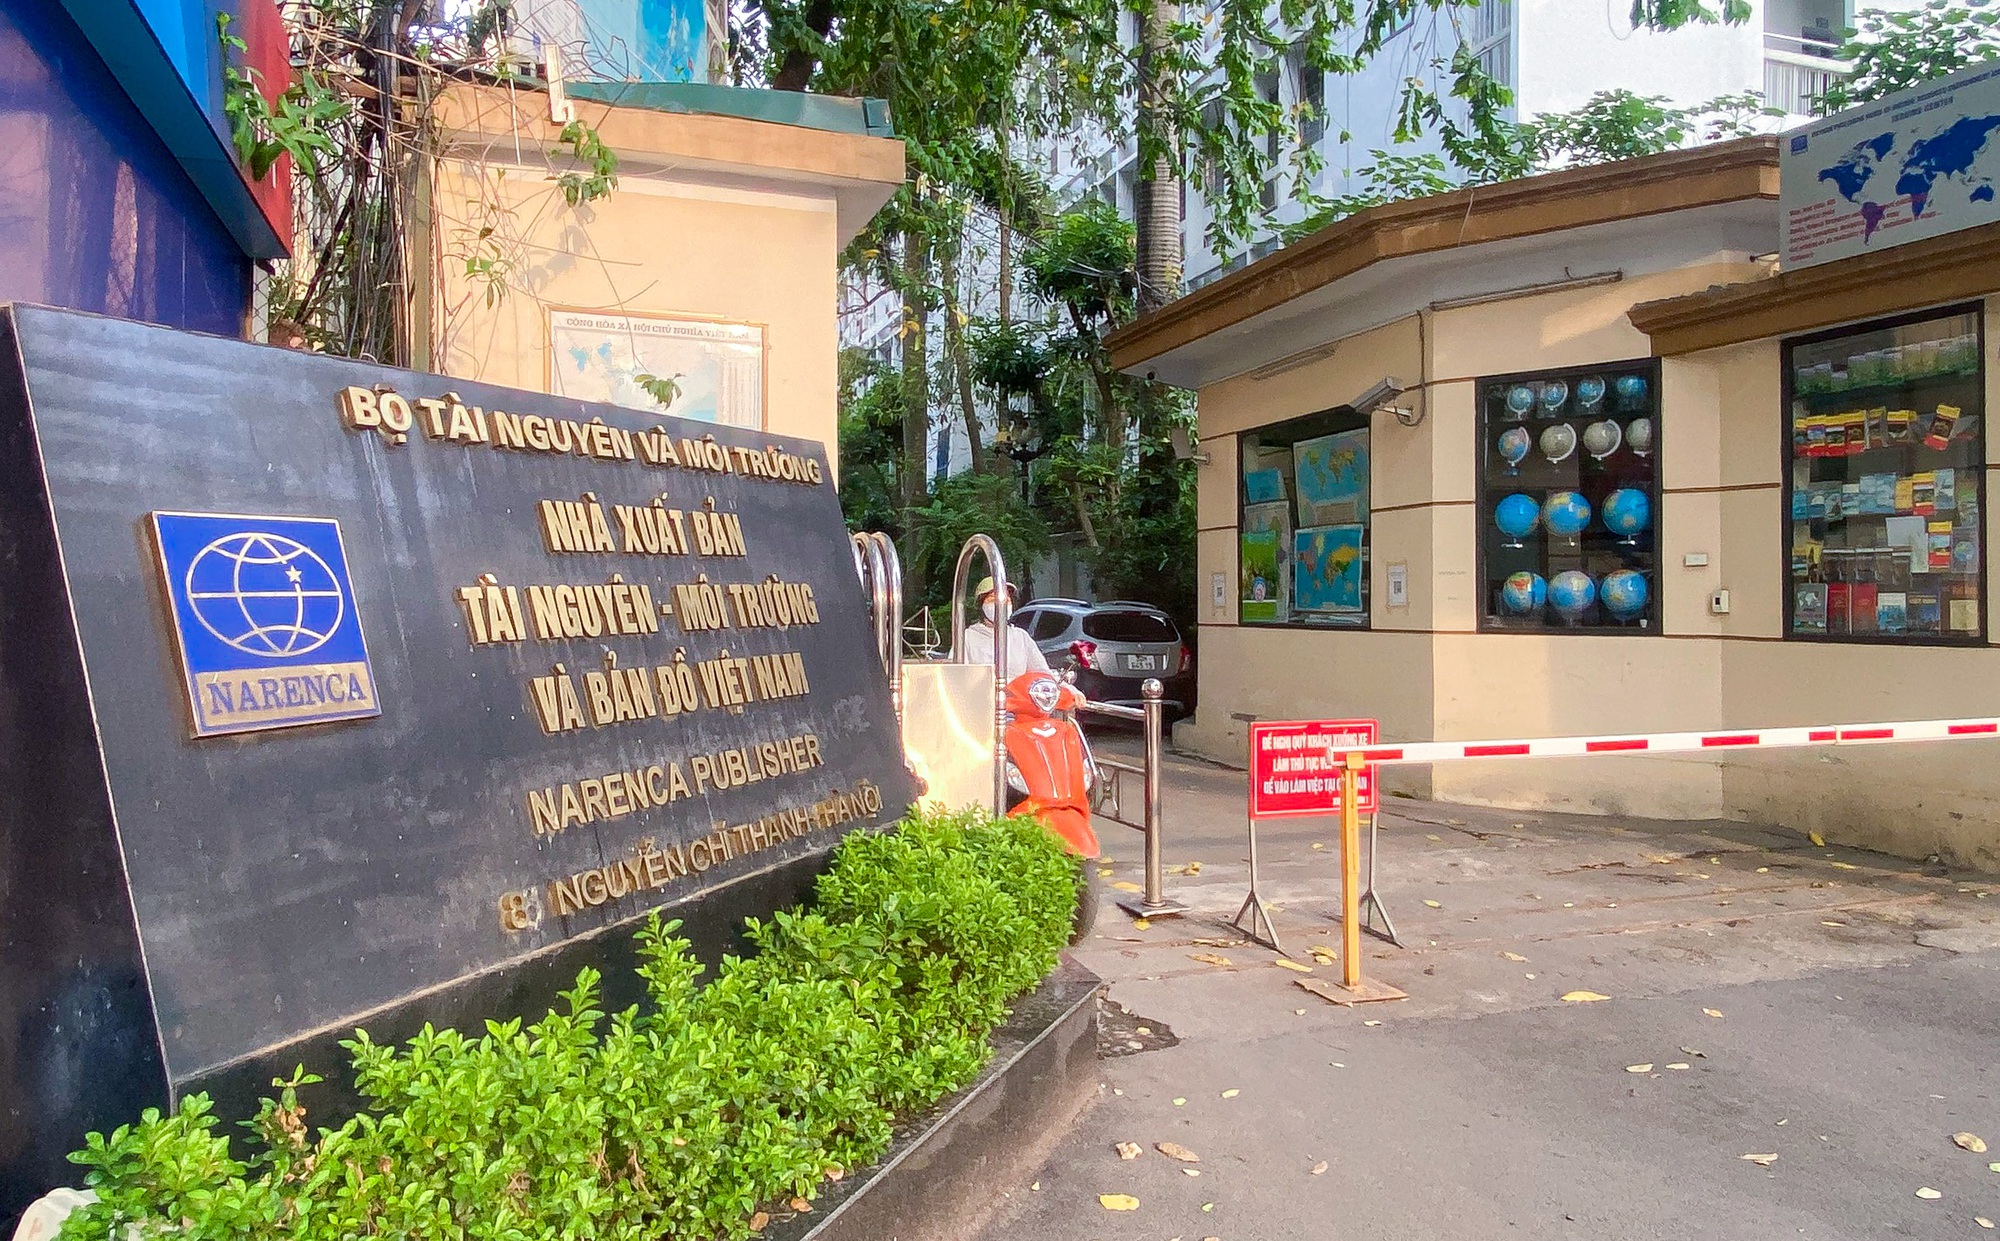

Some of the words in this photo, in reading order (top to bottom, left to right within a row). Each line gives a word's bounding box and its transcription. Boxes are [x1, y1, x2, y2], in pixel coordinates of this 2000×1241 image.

[343, 384, 413, 445] BỘ
[416, 391, 490, 442] TÀI
[488, 410, 635, 460] NGUYÊN
[634, 424, 681, 466] VÀ
[678, 433, 733, 474] MÔI
[732, 444, 823, 485] TRƯỜNG
[537, 491, 616, 552] NHÀ
[612, 491, 690, 556] XUẤT
[688, 495, 747, 556] BẢN
[458, 573, 527, 643] TÀI
[526, 573, 659, 639] NGUYÊN
[673, 573, 730, 631] MÔI
[727, 573, 820, 629] TRƯỜNG
[204, 672, 366, 714] NARENCA
[530, 662, 586, 733] VÀ
[584, 650, 657, 726] BẢN
[654, 646, 698, 715] ĐỒ
[697, 649, 754, 714] VIỆT
[752, 652, 810, 700] NAM
[529, 762, 692, 834] NARENCA
[692, 734, 824, 795] PUBLISHER
[688, 820, 734, 871] CHÍ
[733, 807, 813, 855] THANH
